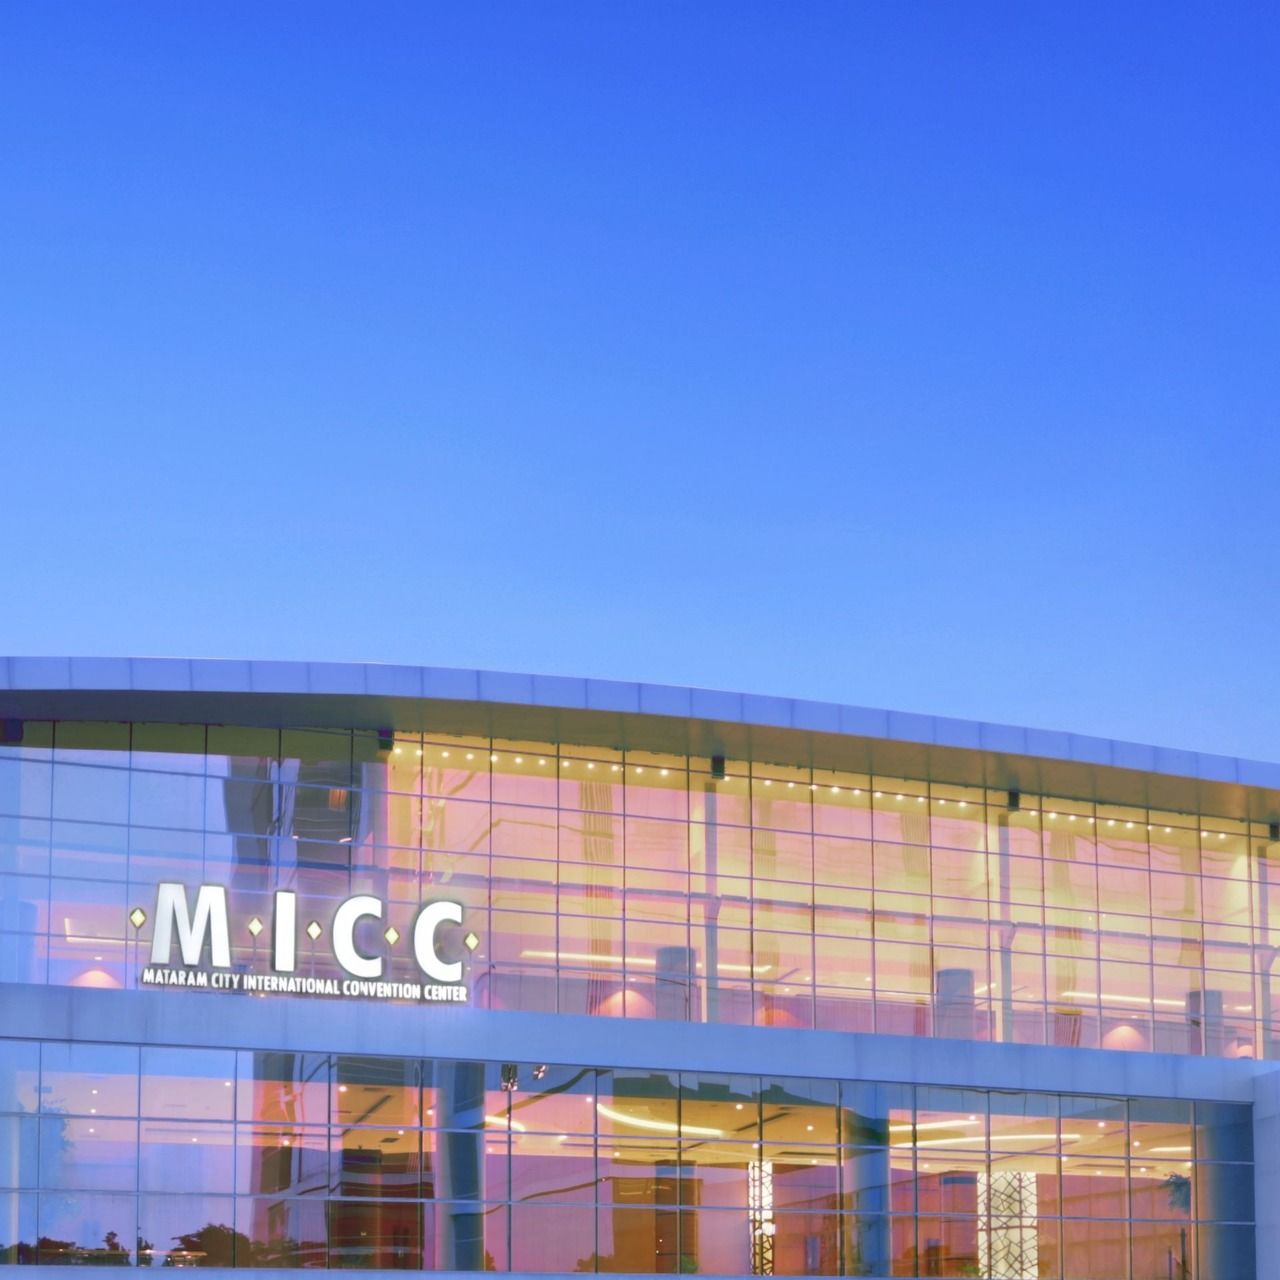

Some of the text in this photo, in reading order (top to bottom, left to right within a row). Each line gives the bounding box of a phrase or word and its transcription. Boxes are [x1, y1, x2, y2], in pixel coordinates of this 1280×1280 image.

[143, 968, 467, 1002] MATARAM CITY INTERNATIONAL CONVENTION CENTER
